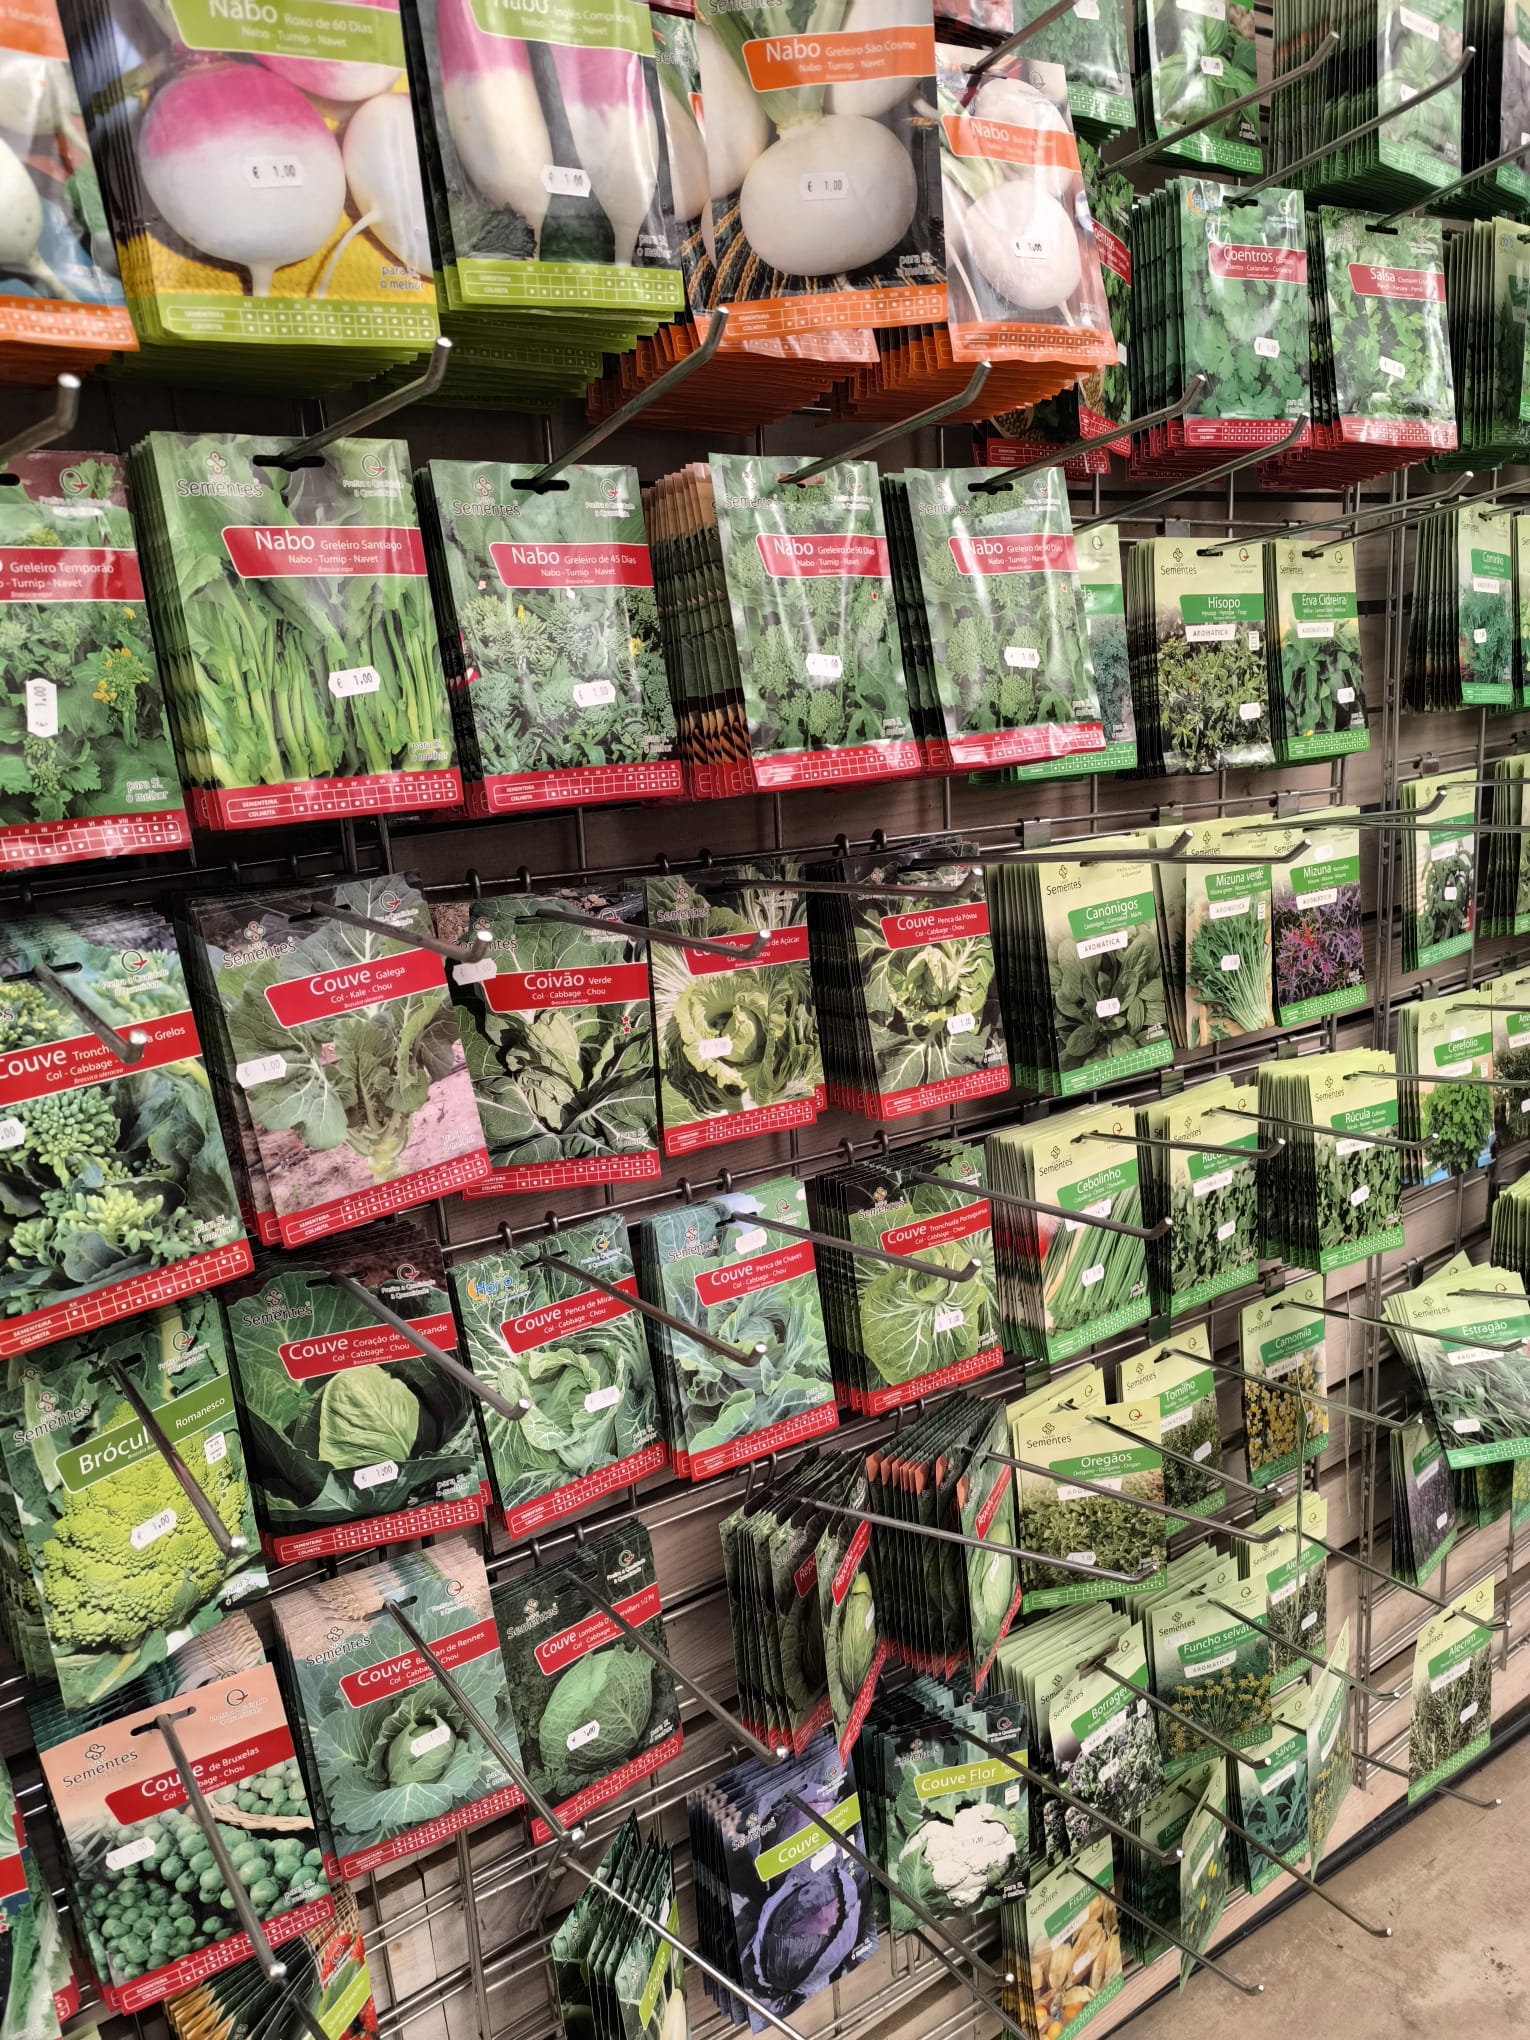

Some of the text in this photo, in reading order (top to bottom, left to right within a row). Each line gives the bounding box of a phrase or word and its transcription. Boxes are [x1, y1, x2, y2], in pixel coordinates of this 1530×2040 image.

[210, 0, 278, 24] Nabo
[315, 15, 330, 28] de
[332, 18, 346, 32] 60
[766, 39, 917, 63] Nabo Greleiro São Cosme
[971, 121, 1009, 142] Nabo
[825, 179, 843, 192] 1.00
[1224, 247, 1273, 264] Coentros
[1370, 269, 1395, 282] Salsa
[177, 478, 263, 497] Sementes
[453, 502, 520, 517] Sementes
[255, 529, 402, 551] Nabo Greleiro Santiago
[774, 539, 845, 555] Nabo Greleiro
[289, 554, 379, 566] Nabo Turnip Navet
[512, 548, 636, 565] Nabo Greleiro de 45 Dias
[10, 561, 114, 575] Greleiro Temporão
[541, 567, 616, 578] Nabo Turnip Navet
[1161, 566, 1197, 576] Sementes
[12, 578, 83, 590] Turnip Navet
[1208, 597, 1241, 611] Hisopo
[1302, 594, 1346, 606] Erva Cidreira
[1193, 628, 1228, 637] AROMÁTICA
[353, 673, 373, 685] 1.00
[242, 798, 278, 808] SEMENTEIRA
[248, 809, 276, 818] COLHEITA
[1216, 868, 1264, 887] Mizuna verde
[1304, 864, 1331, 878] Mizuna
[1047, 880, 1081, 895] Sementes
[657, 907, 709, 921] Sementes
[1086, 899, 1138, 921] Canónigos
[897, 914, 934, 931] Couve
[780, 936, 800, 946] Açúcar
[915, 930, 926, 938] Col
[1084, 938, 1120, 952] AROMÁTICA
[223, 940, 296, 968] Sementes
[310, 967, 405, 995] Couve Galega
[524, 972, 612, 990] Coivão Verde
[331, 981, 392, 1004] Col Kale Chou
[532, 987, 606, 999] Col Cabbage Chou
[155, 1026, 185, 1043] Grelos
[1448, 1038, 1478, 1052] Cerefólio
[46, 1061, 112, 1081] Col Cabbage
[1315, 1090, 1344, 1101] Sementes
[1346, 1110, 1370, 1124] Rúcula
[1039, 1157, 1072, 1177] Sementes
[1076, 1169, 1121, 1193] Cebolinho
[887, 1223, 927, 1244] Couve
[711, 1263, 752, 1286] Couve
[756, 1263, 771, 1272] Penca
[733, 1268, 787, 1289] Col Cabbage Chou
[242, 1303, 312, 1327] Sementes
[514, 1302, 596, 1334] Couve Penca de
[544, 1307, 606, 1334] Col Cabbage Chou
[1413, 1306, 1449, 1318] Sementes
[13, 1320, 51, 1336] SEMENTEIRA
[1462, 1320, 1508, 1335] Estragão
[20, 1331, 50, 1345] COLHEITA
[288, 1337, 348, 1360] Couve
[353, 1333, 388, 1348] Coração
[417, 1324, 448, 1337] Grande
[1275, 1328, 1311, 1347] Camomila
[332, 1343, 409, 1362] Col Cabbage Chou
[1126, 1372, 1157, 1390] Sementes
[1165, 1380, 1195, 1400] Tomilho
[176, 1398, 225, 1428] Romanesco
[13, 1403, 91, 1446] Sementes
[1027, 1434, 1071, 1448] Sementes
[1081, 1452, 1132, 1467] Oregãos
[152, 1514, 170, 1532] 1.00
[1159, 1618, 1195, 1635] Sementes
[306, 1635, 371, 1665] Sementes
[542, 1630, 576, 1658] Couve
[1183, 1634, 1221, 1654] Funcho
[1448, 1633, 1476, 1657] Alecrim
[357, 1631, 484, 1686] Couve de Rennes
[441, 1653, 459, 1664] Chou
[1192, 1656, 1229, 1671] AROMÁTICA
[1275, 1742, 1295, 1757] Sálvia
[62, 1749, 138, 1788] Sementes
[141, 1746, 259, 1798] Coue de Bruxelas
[163, 1764, 245, 1801] Col Chou
[921, 1767, 997, 1791] Couve Flor
[778, 1831, 820, 1862] Couve
